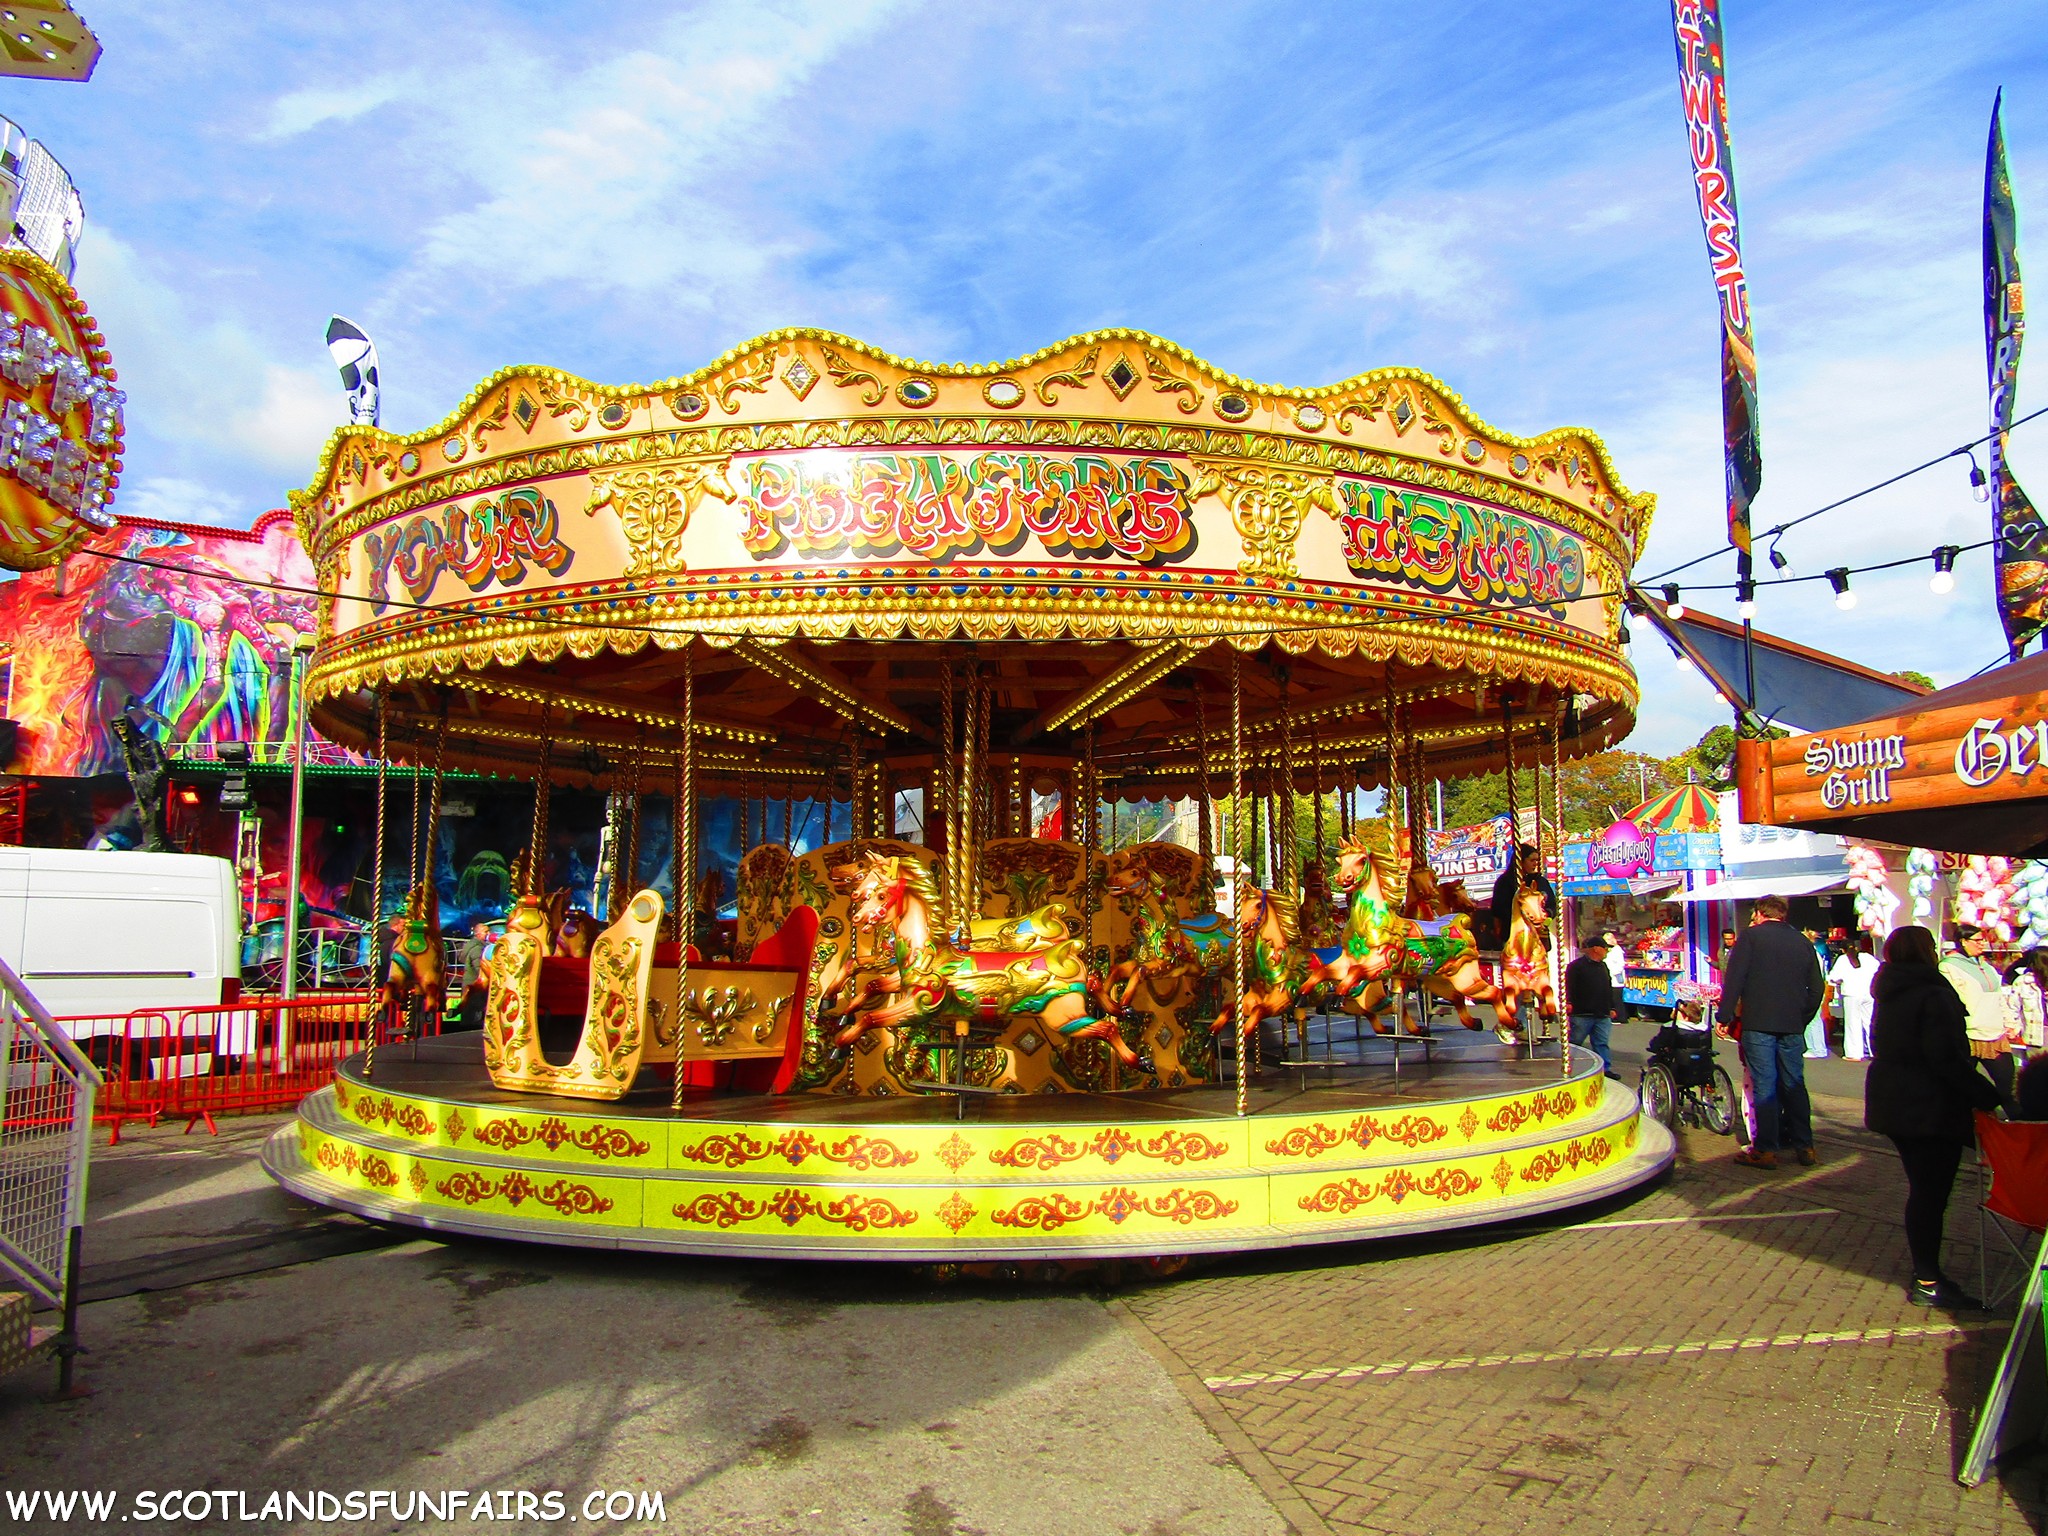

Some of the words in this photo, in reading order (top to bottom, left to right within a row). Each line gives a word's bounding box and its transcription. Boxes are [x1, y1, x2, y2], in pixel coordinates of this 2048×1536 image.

[364, 487, 572, 616] YOUR
[738, 453, 1194, 564] PLEASURE
[1340, 481, 1583, 620] HENRY
[1804, 734, 1904, 775] Swing
[1820, 767, 1890, 808] Grill
[1431, 856, 1496, 877] DINER
